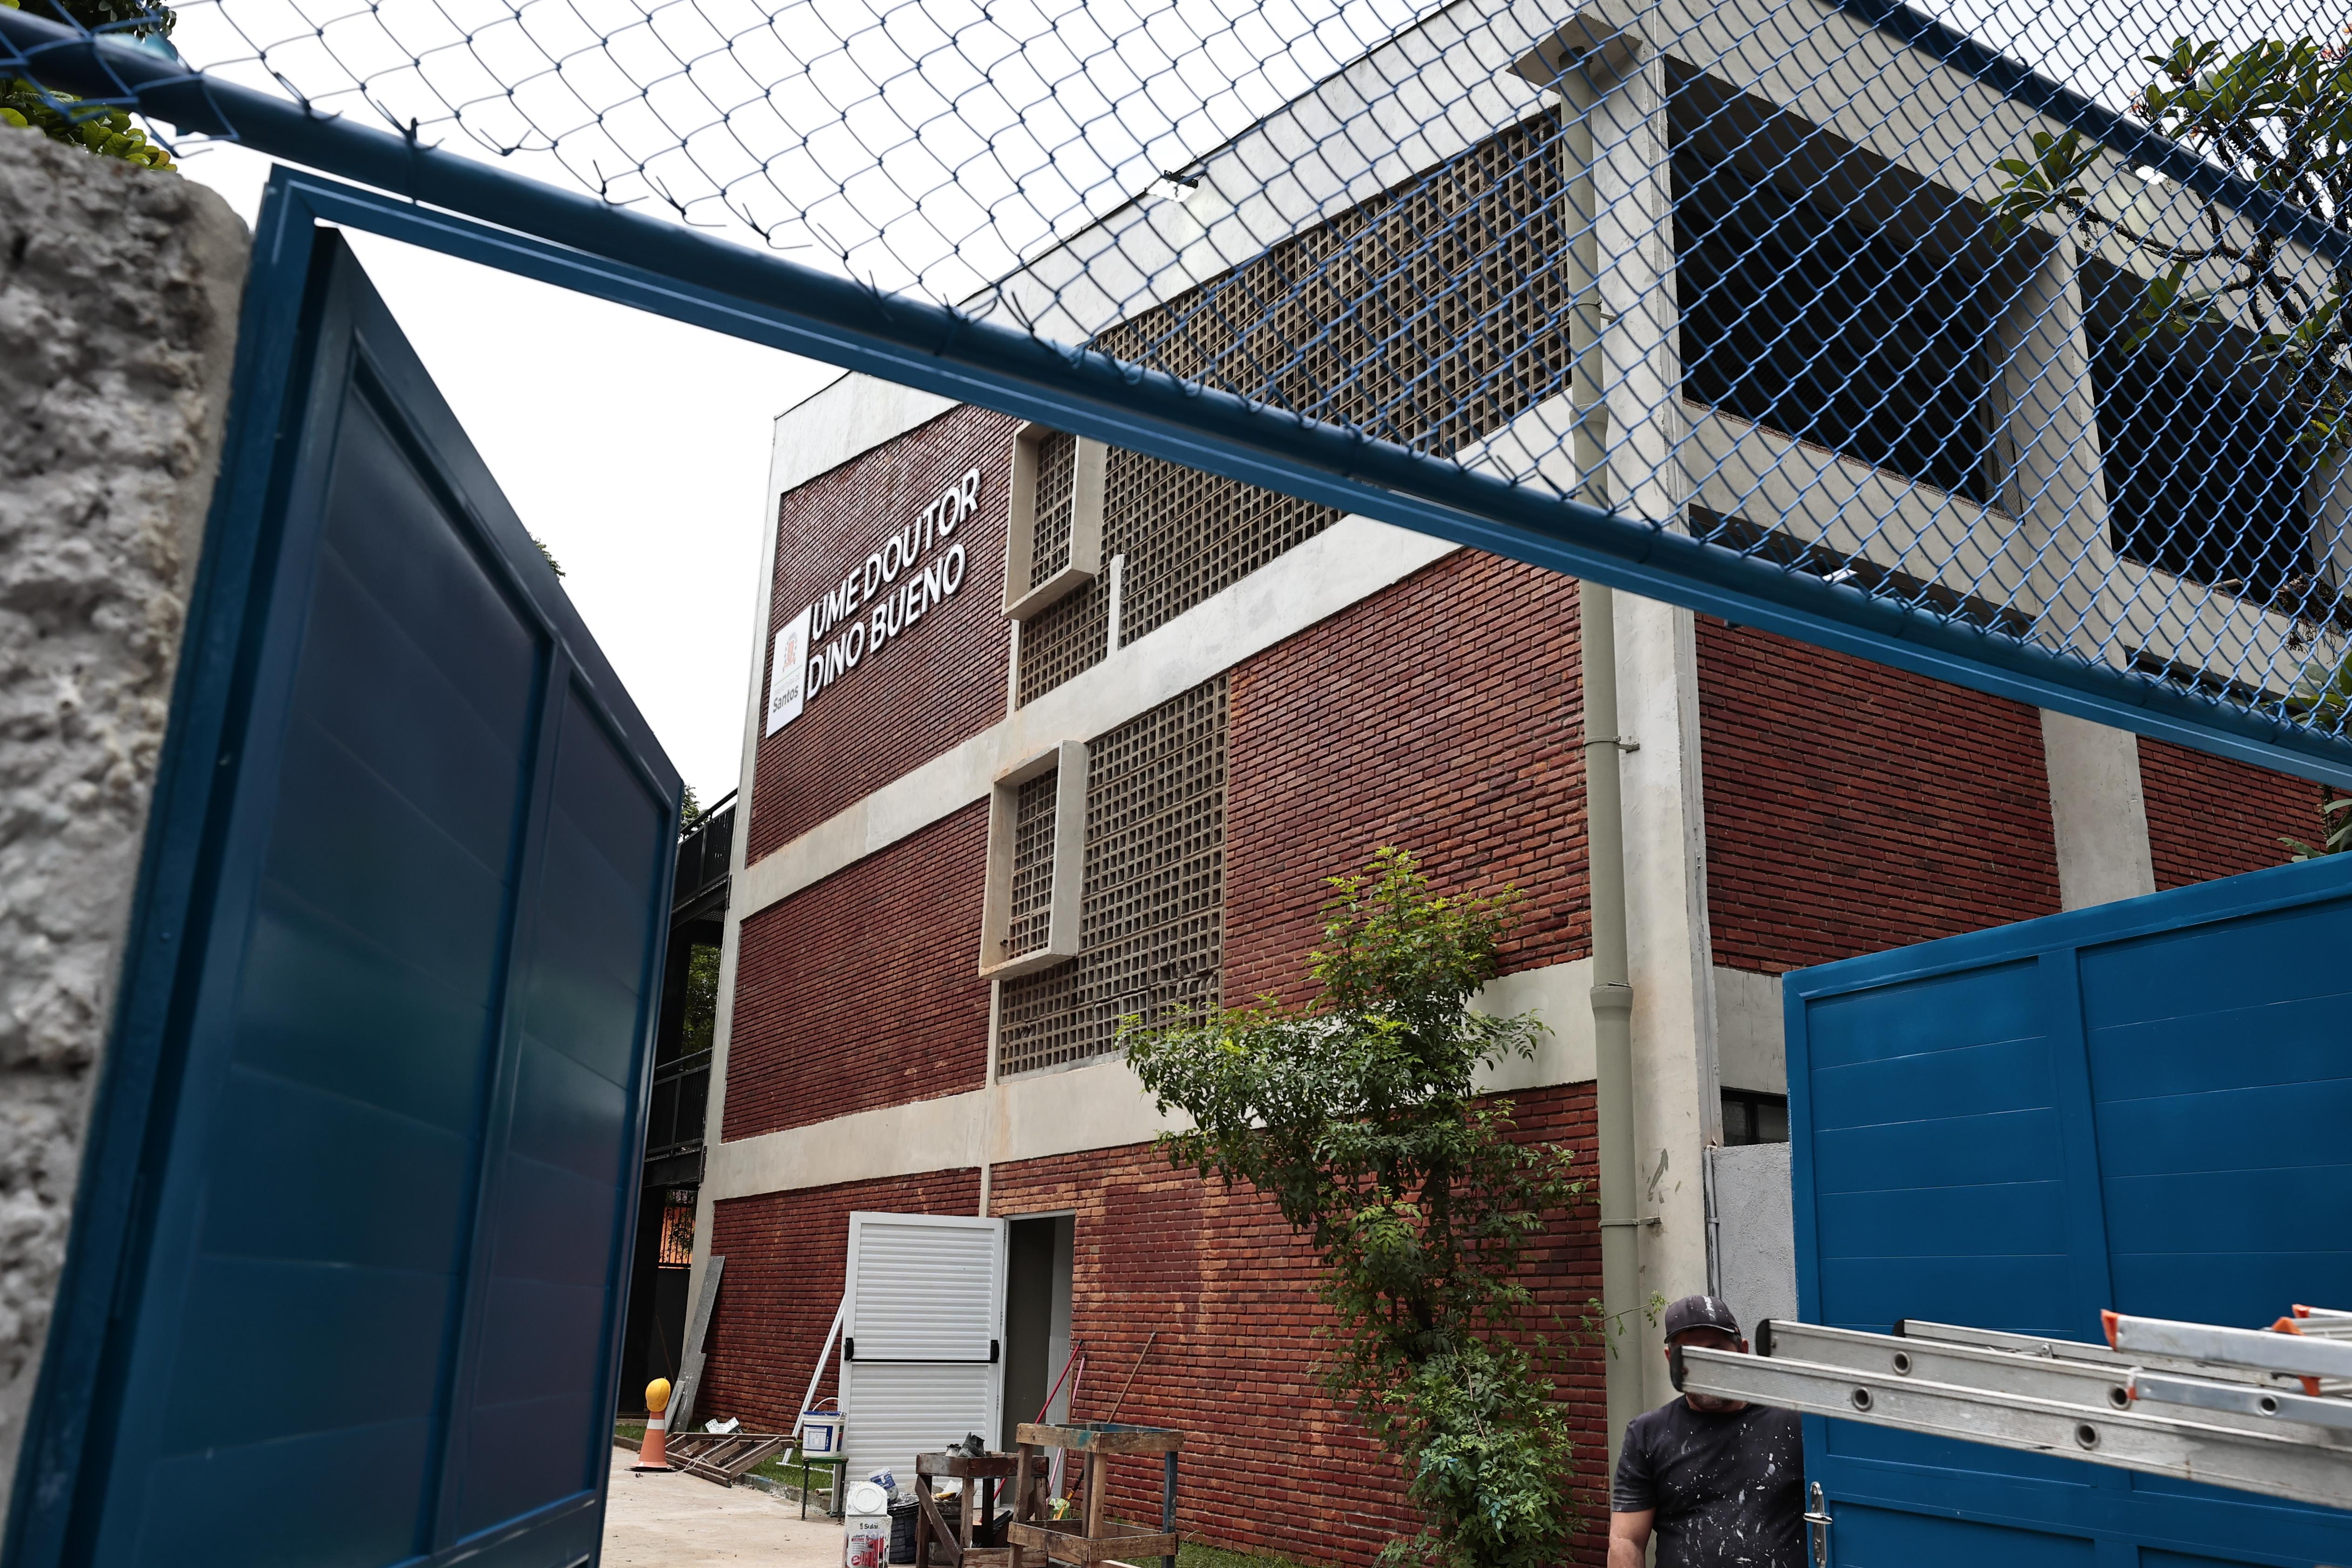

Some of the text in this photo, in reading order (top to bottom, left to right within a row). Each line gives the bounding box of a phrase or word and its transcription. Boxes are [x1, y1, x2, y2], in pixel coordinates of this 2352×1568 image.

[806, 543, 966, 700] DINO BUENO
[811, 467, 980, 641] UME DOUTOR
[773, 685, 799, 713] Santos
